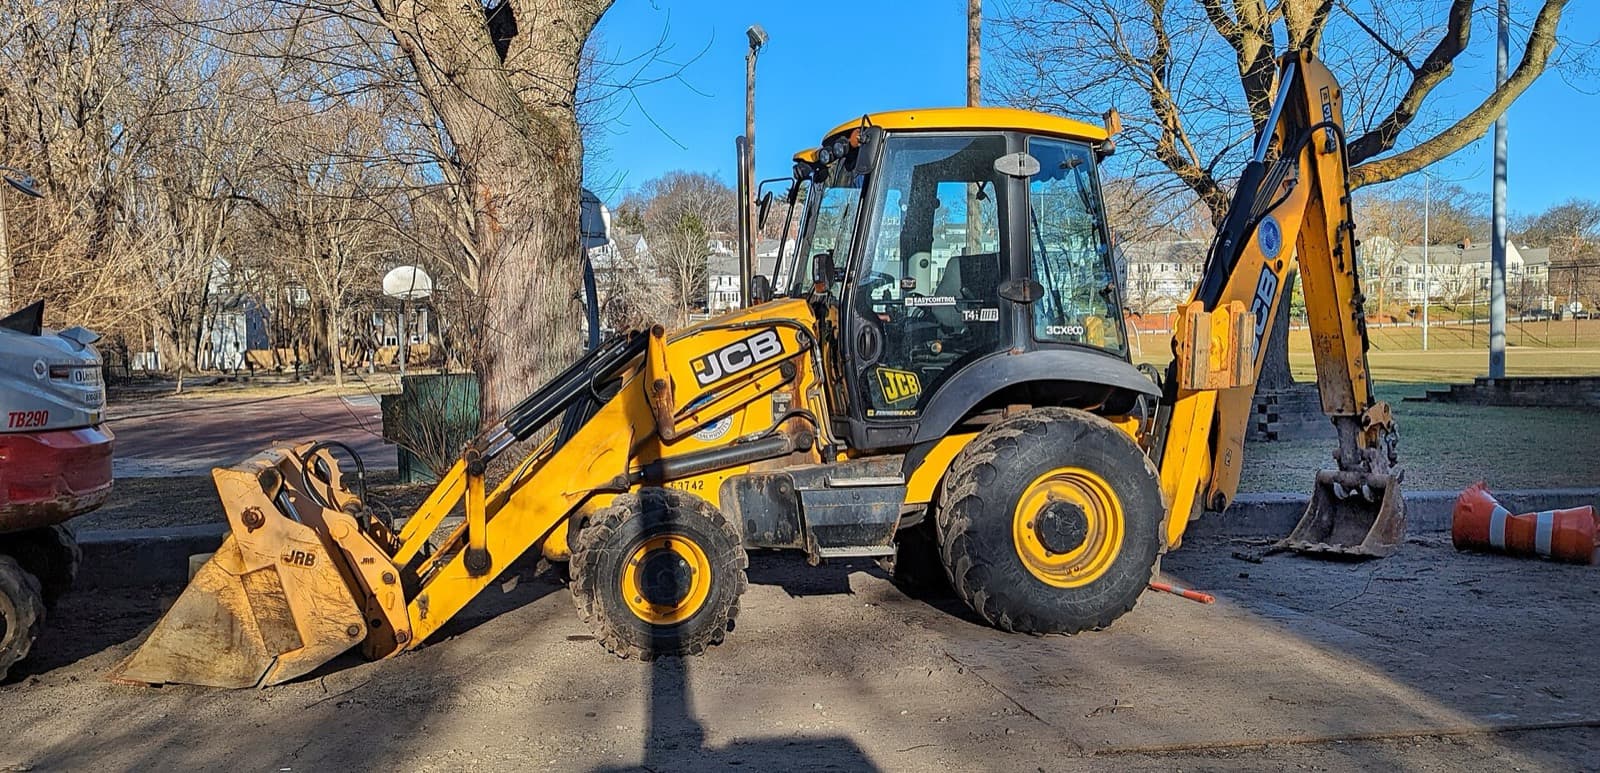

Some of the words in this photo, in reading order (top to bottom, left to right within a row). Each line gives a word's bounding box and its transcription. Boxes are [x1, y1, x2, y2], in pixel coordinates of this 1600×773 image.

[914, 296, 956, 304] EASYCONTROL
[962, 310, 979, 321] T4i
[697, 330, 782, 384] JCB
[885, 371, 919, 400] JCB
[8, 410, 49, 428] TB290
[283, 549, 316, 567] JRB
